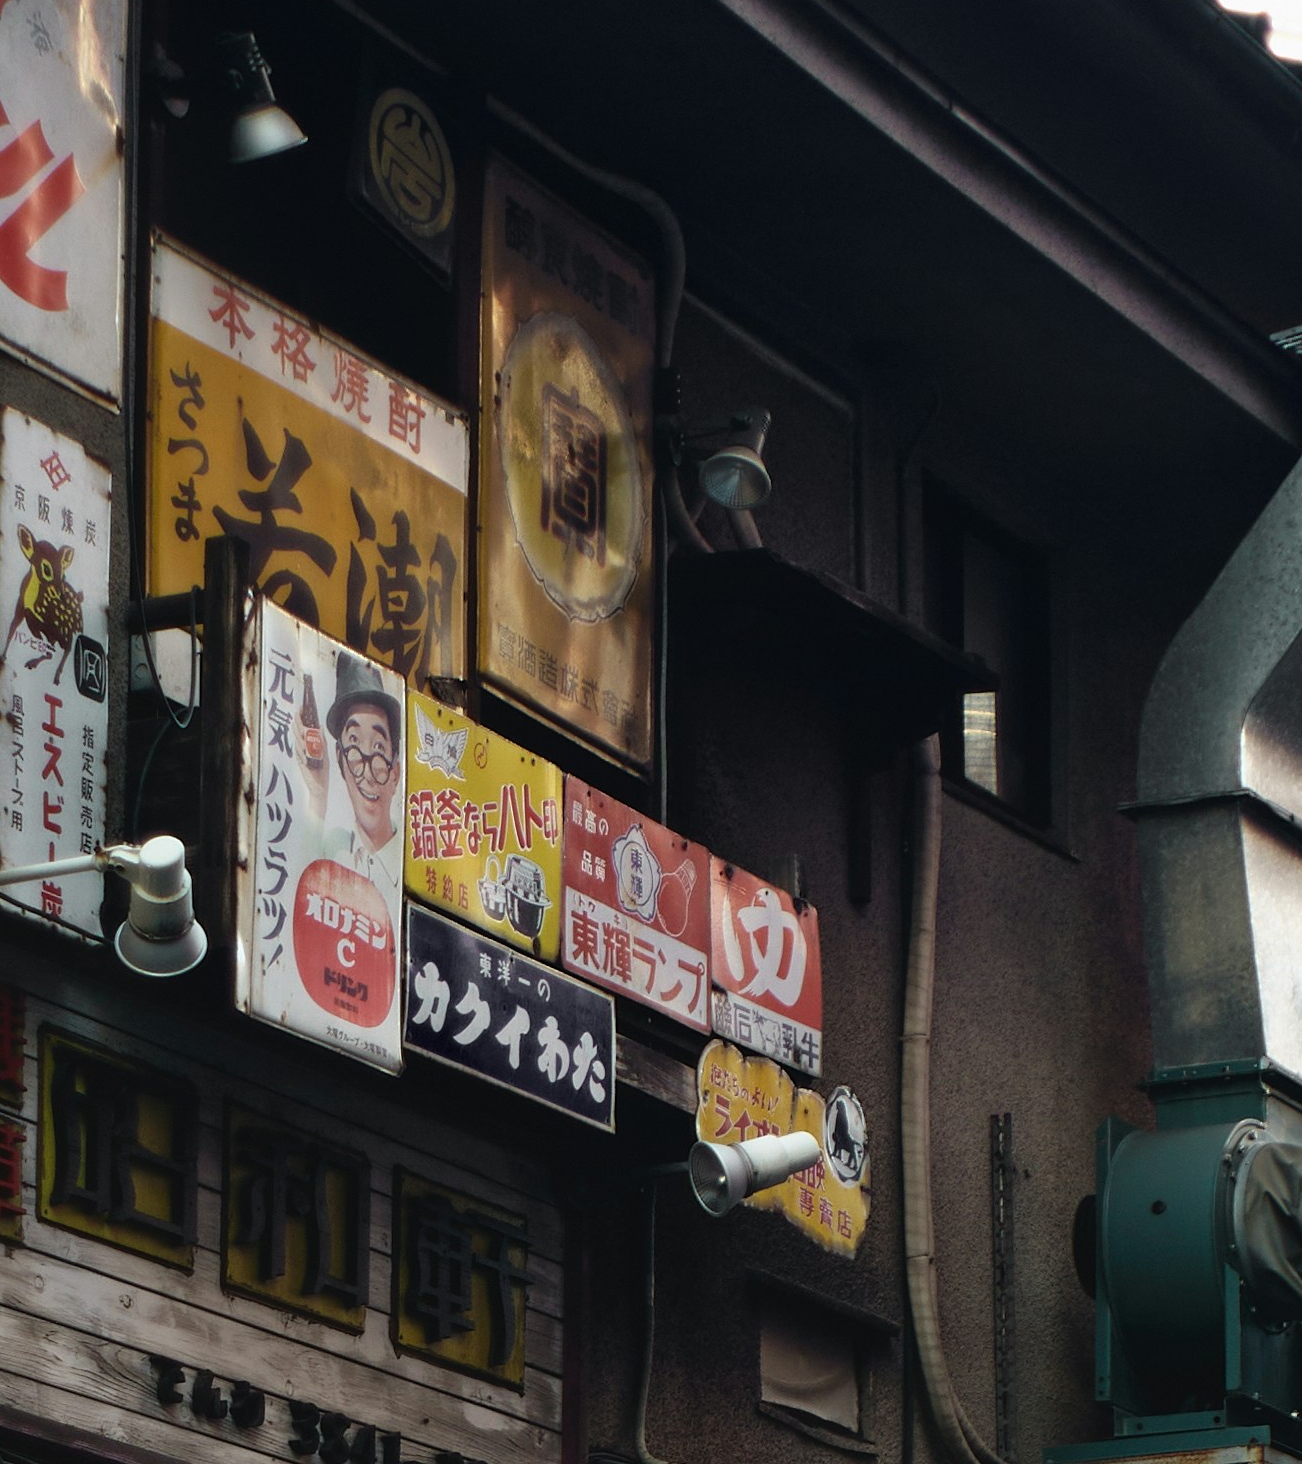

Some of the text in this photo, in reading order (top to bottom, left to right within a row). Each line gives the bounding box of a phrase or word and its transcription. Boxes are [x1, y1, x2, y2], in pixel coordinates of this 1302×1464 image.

[168, 360, 209, 542] さつま
[572, 801, 609, 836] 最高の
[425, 866, 470, 910] 特約店
[581, 850, 606, 882] 品質
[305, 892, 387, 950] オロナミン
[336, 937, 356, 968] C
[571, 910, 706, 1014] 東輝ランプ
[324, 967, 369, 1003] ドリンク
[479, 953, 551, 1002] 東洋一の
[412, 961, 606, 1103] カクイわた
[52, 1053, 535, 1368] 昭和軒
